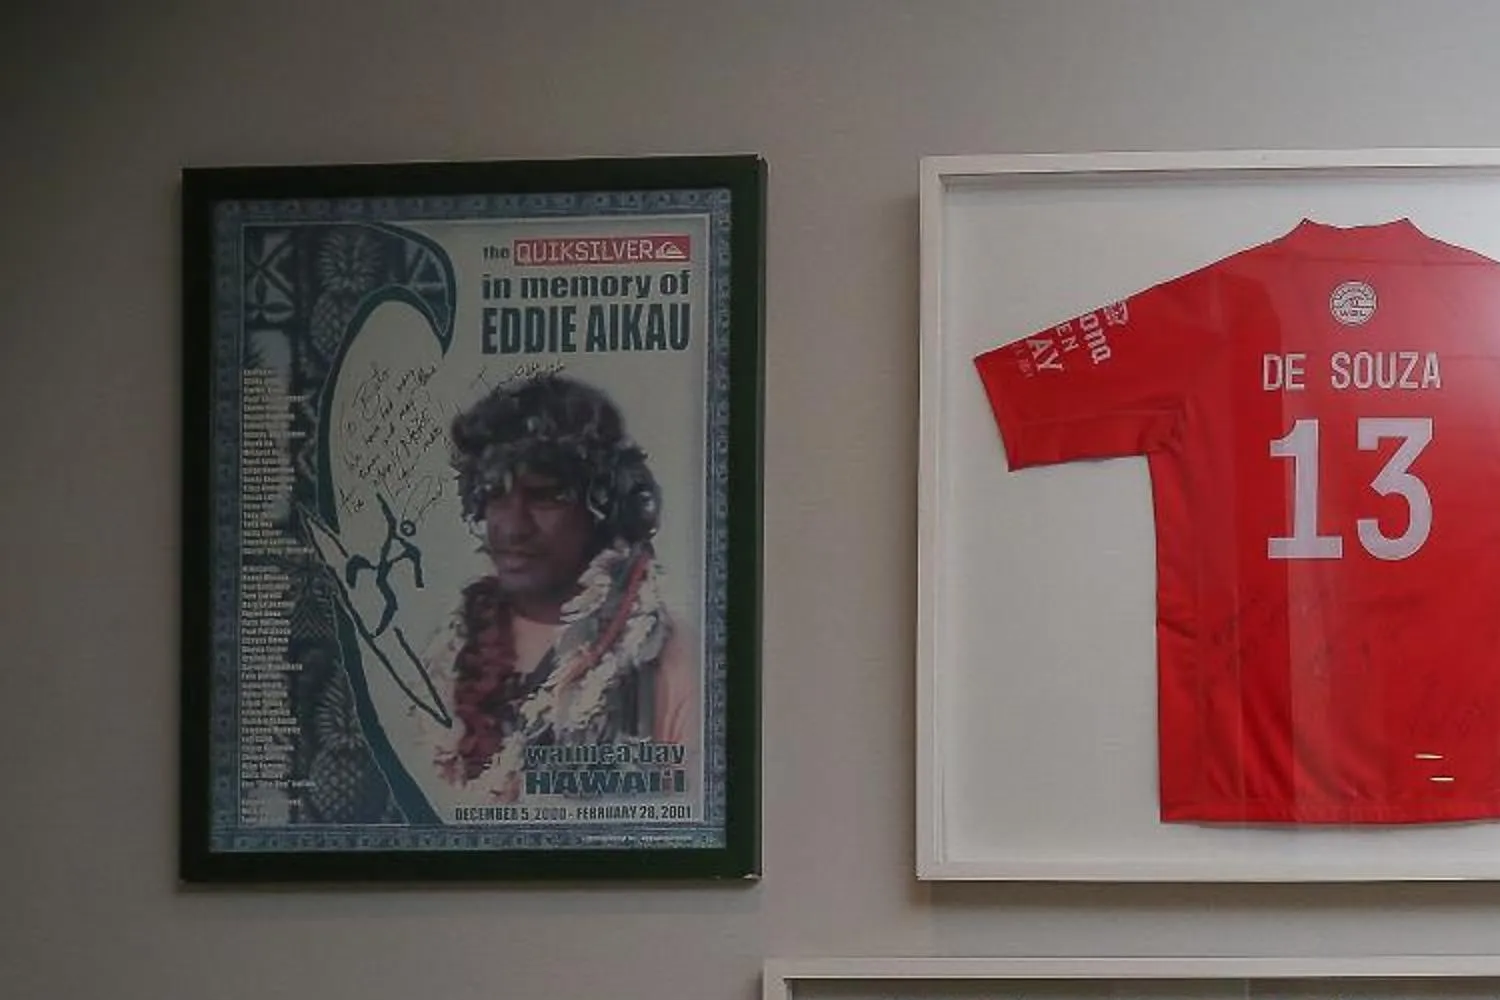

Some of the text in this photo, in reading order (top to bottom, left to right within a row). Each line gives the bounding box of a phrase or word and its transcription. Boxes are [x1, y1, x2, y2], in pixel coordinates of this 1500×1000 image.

[483, 239, 654, 262] the QUIKSILVER
[482, 269, 691, 299] in memory of
[482, 303, 691, 354] EDDIE AIKAU
[1262, 350, 1443, 391] DE SOUZA
[1266, 416, 1434, 561] 13
[526, 741, 685, 765] waimea bay
[455, 807, 518, 821] DECEMBER
[577, 806, 636, 820] FEBRUARY
[661, 805, 692, 819] 2001
